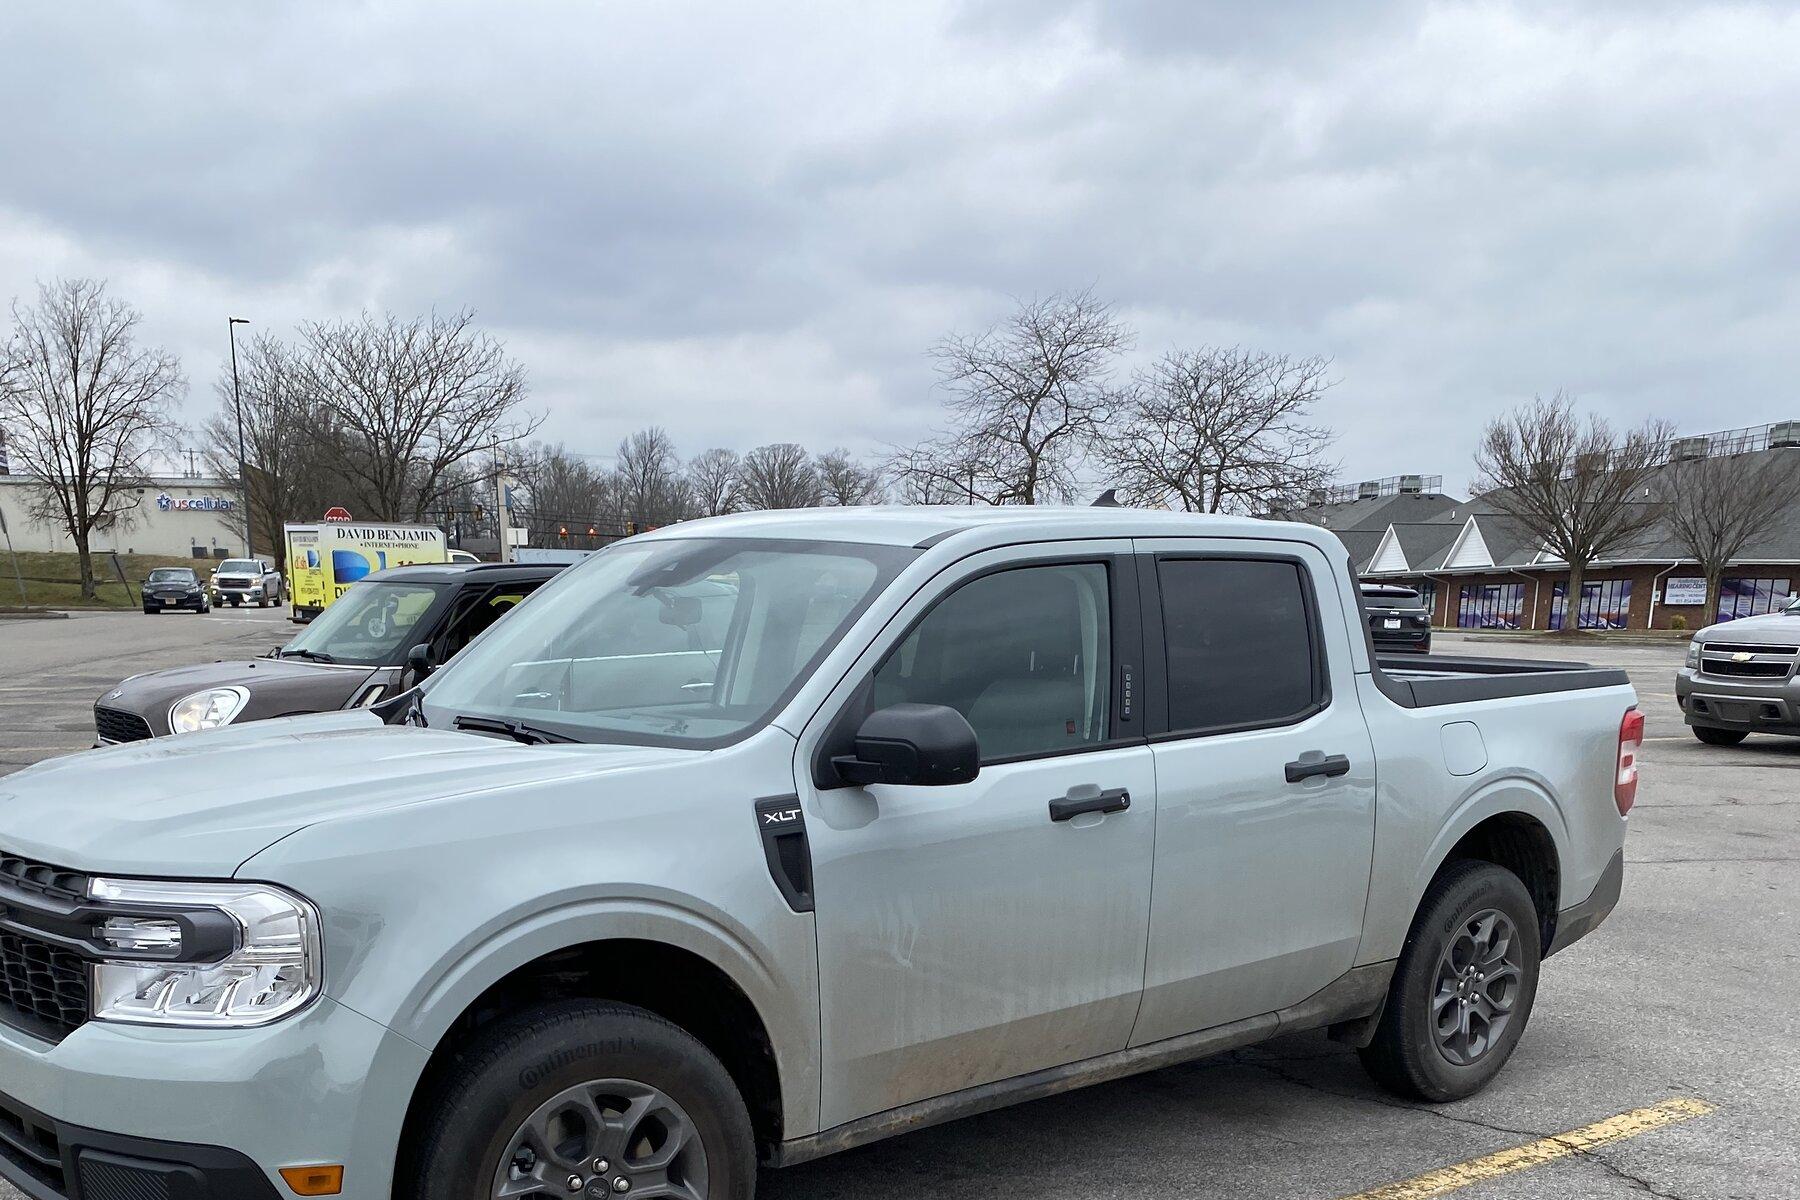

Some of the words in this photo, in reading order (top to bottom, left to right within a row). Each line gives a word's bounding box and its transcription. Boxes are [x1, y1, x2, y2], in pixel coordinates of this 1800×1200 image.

[337, 528, 375, 540] DAVID
[377, 529, 437, 542] BENJAMIN
[764, 809, 801, 824] XLT
